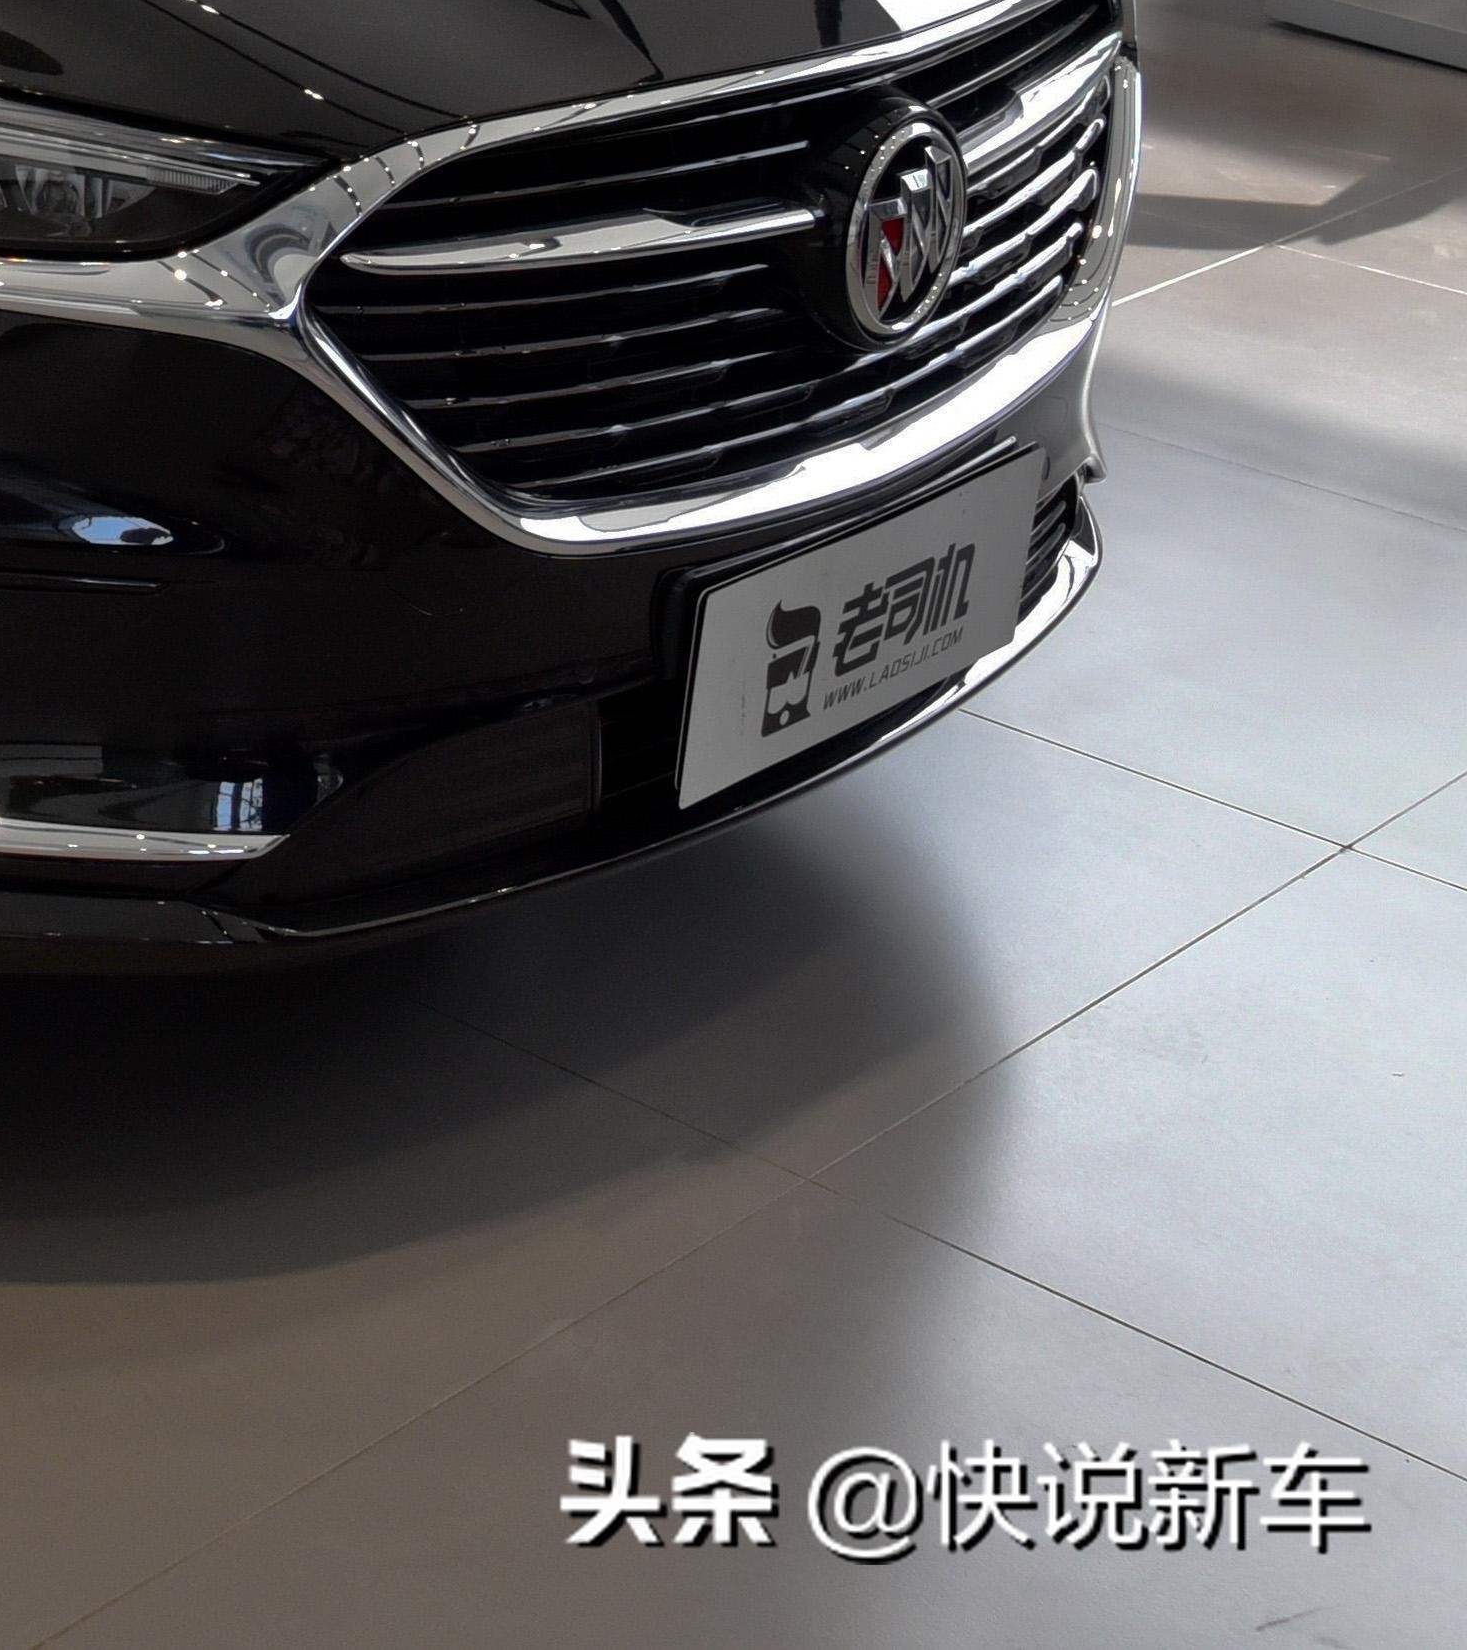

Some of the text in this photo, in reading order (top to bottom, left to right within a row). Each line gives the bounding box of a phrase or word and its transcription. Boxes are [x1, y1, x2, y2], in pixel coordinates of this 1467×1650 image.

[832, 542, 976, 677] 老司机
[822, 626, 964, 711] WWW.LAOSIJI.COM
